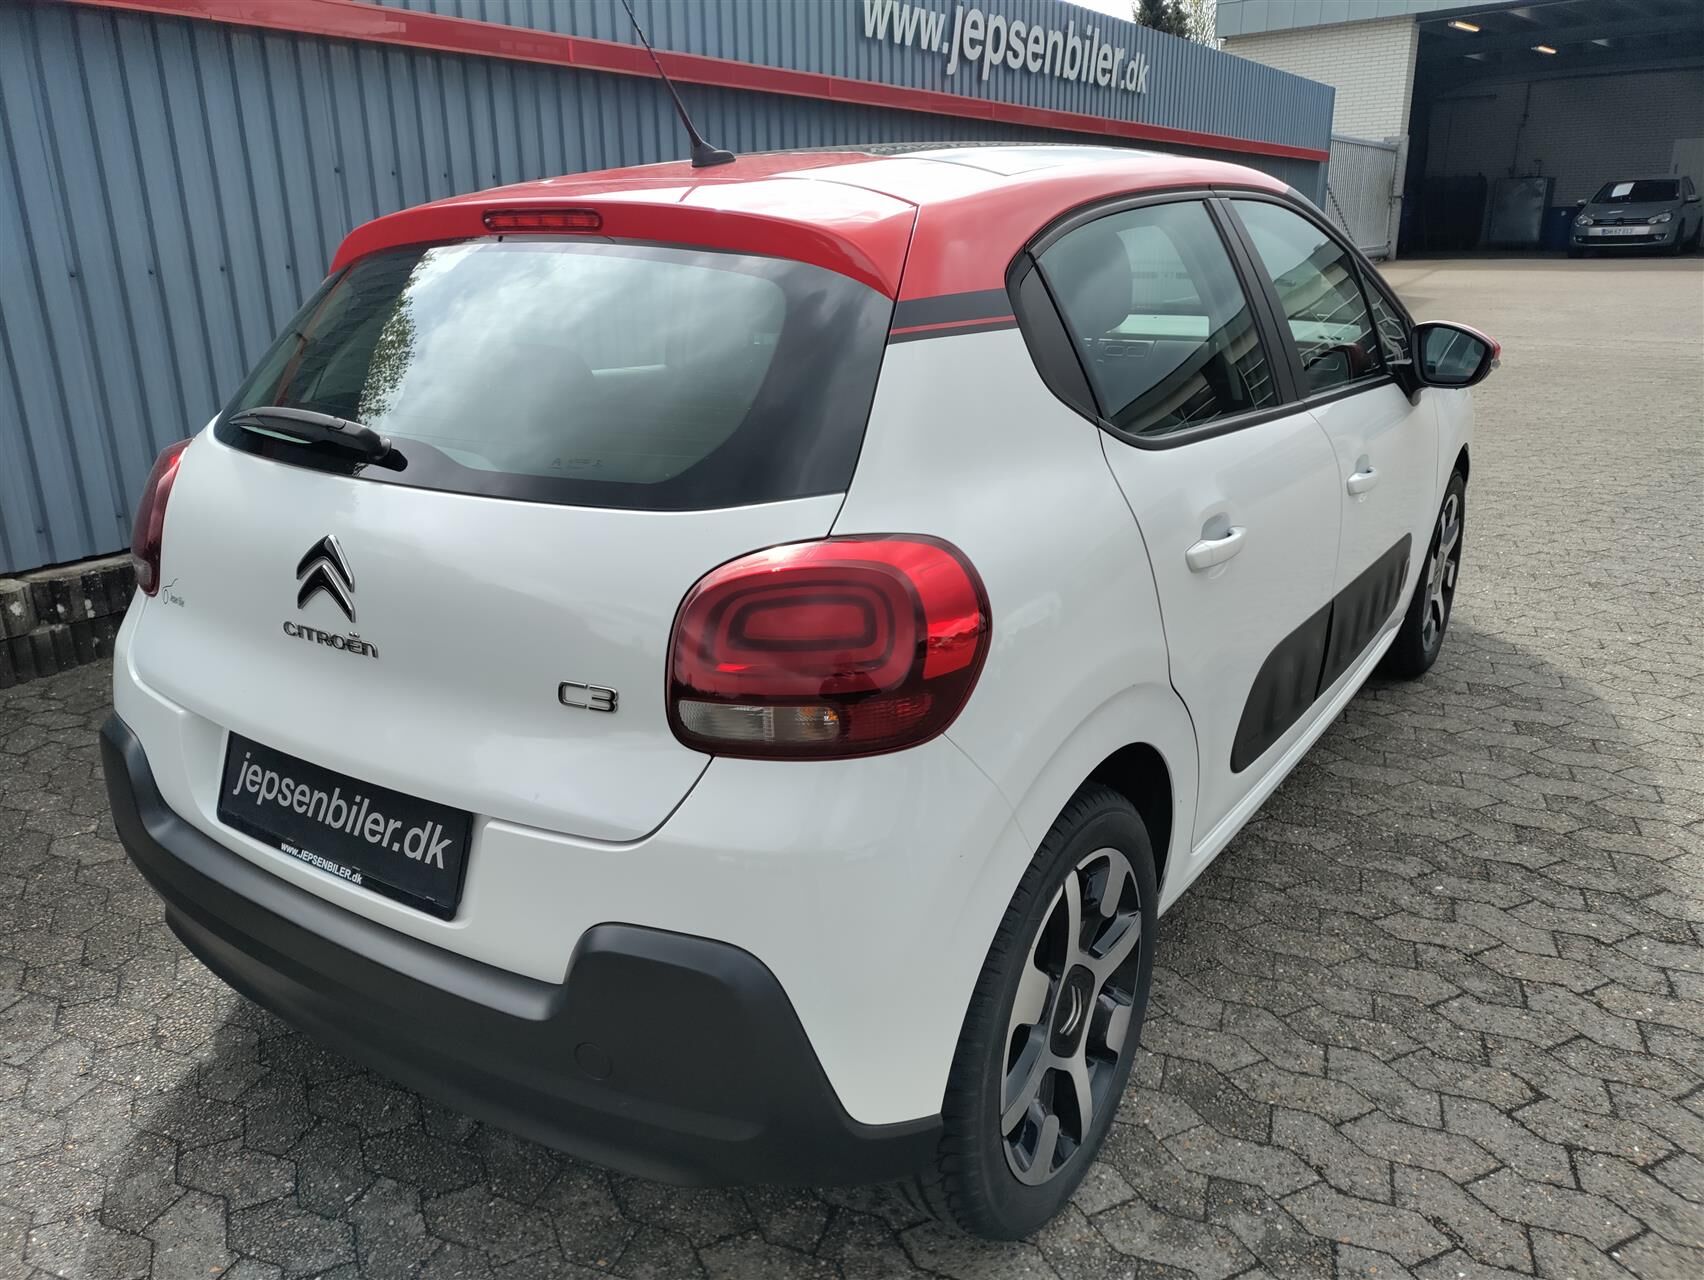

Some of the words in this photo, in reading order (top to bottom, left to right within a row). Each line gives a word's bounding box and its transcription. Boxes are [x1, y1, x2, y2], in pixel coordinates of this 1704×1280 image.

[863, 0, 1150, 94] www.jepsenbiler.dk
[557, 680, 619, 714] C3
[232, 752, 453, 870] jepsenbiler.dk
[280, 842, 363, 885] www.JEPSENBILER.dk
